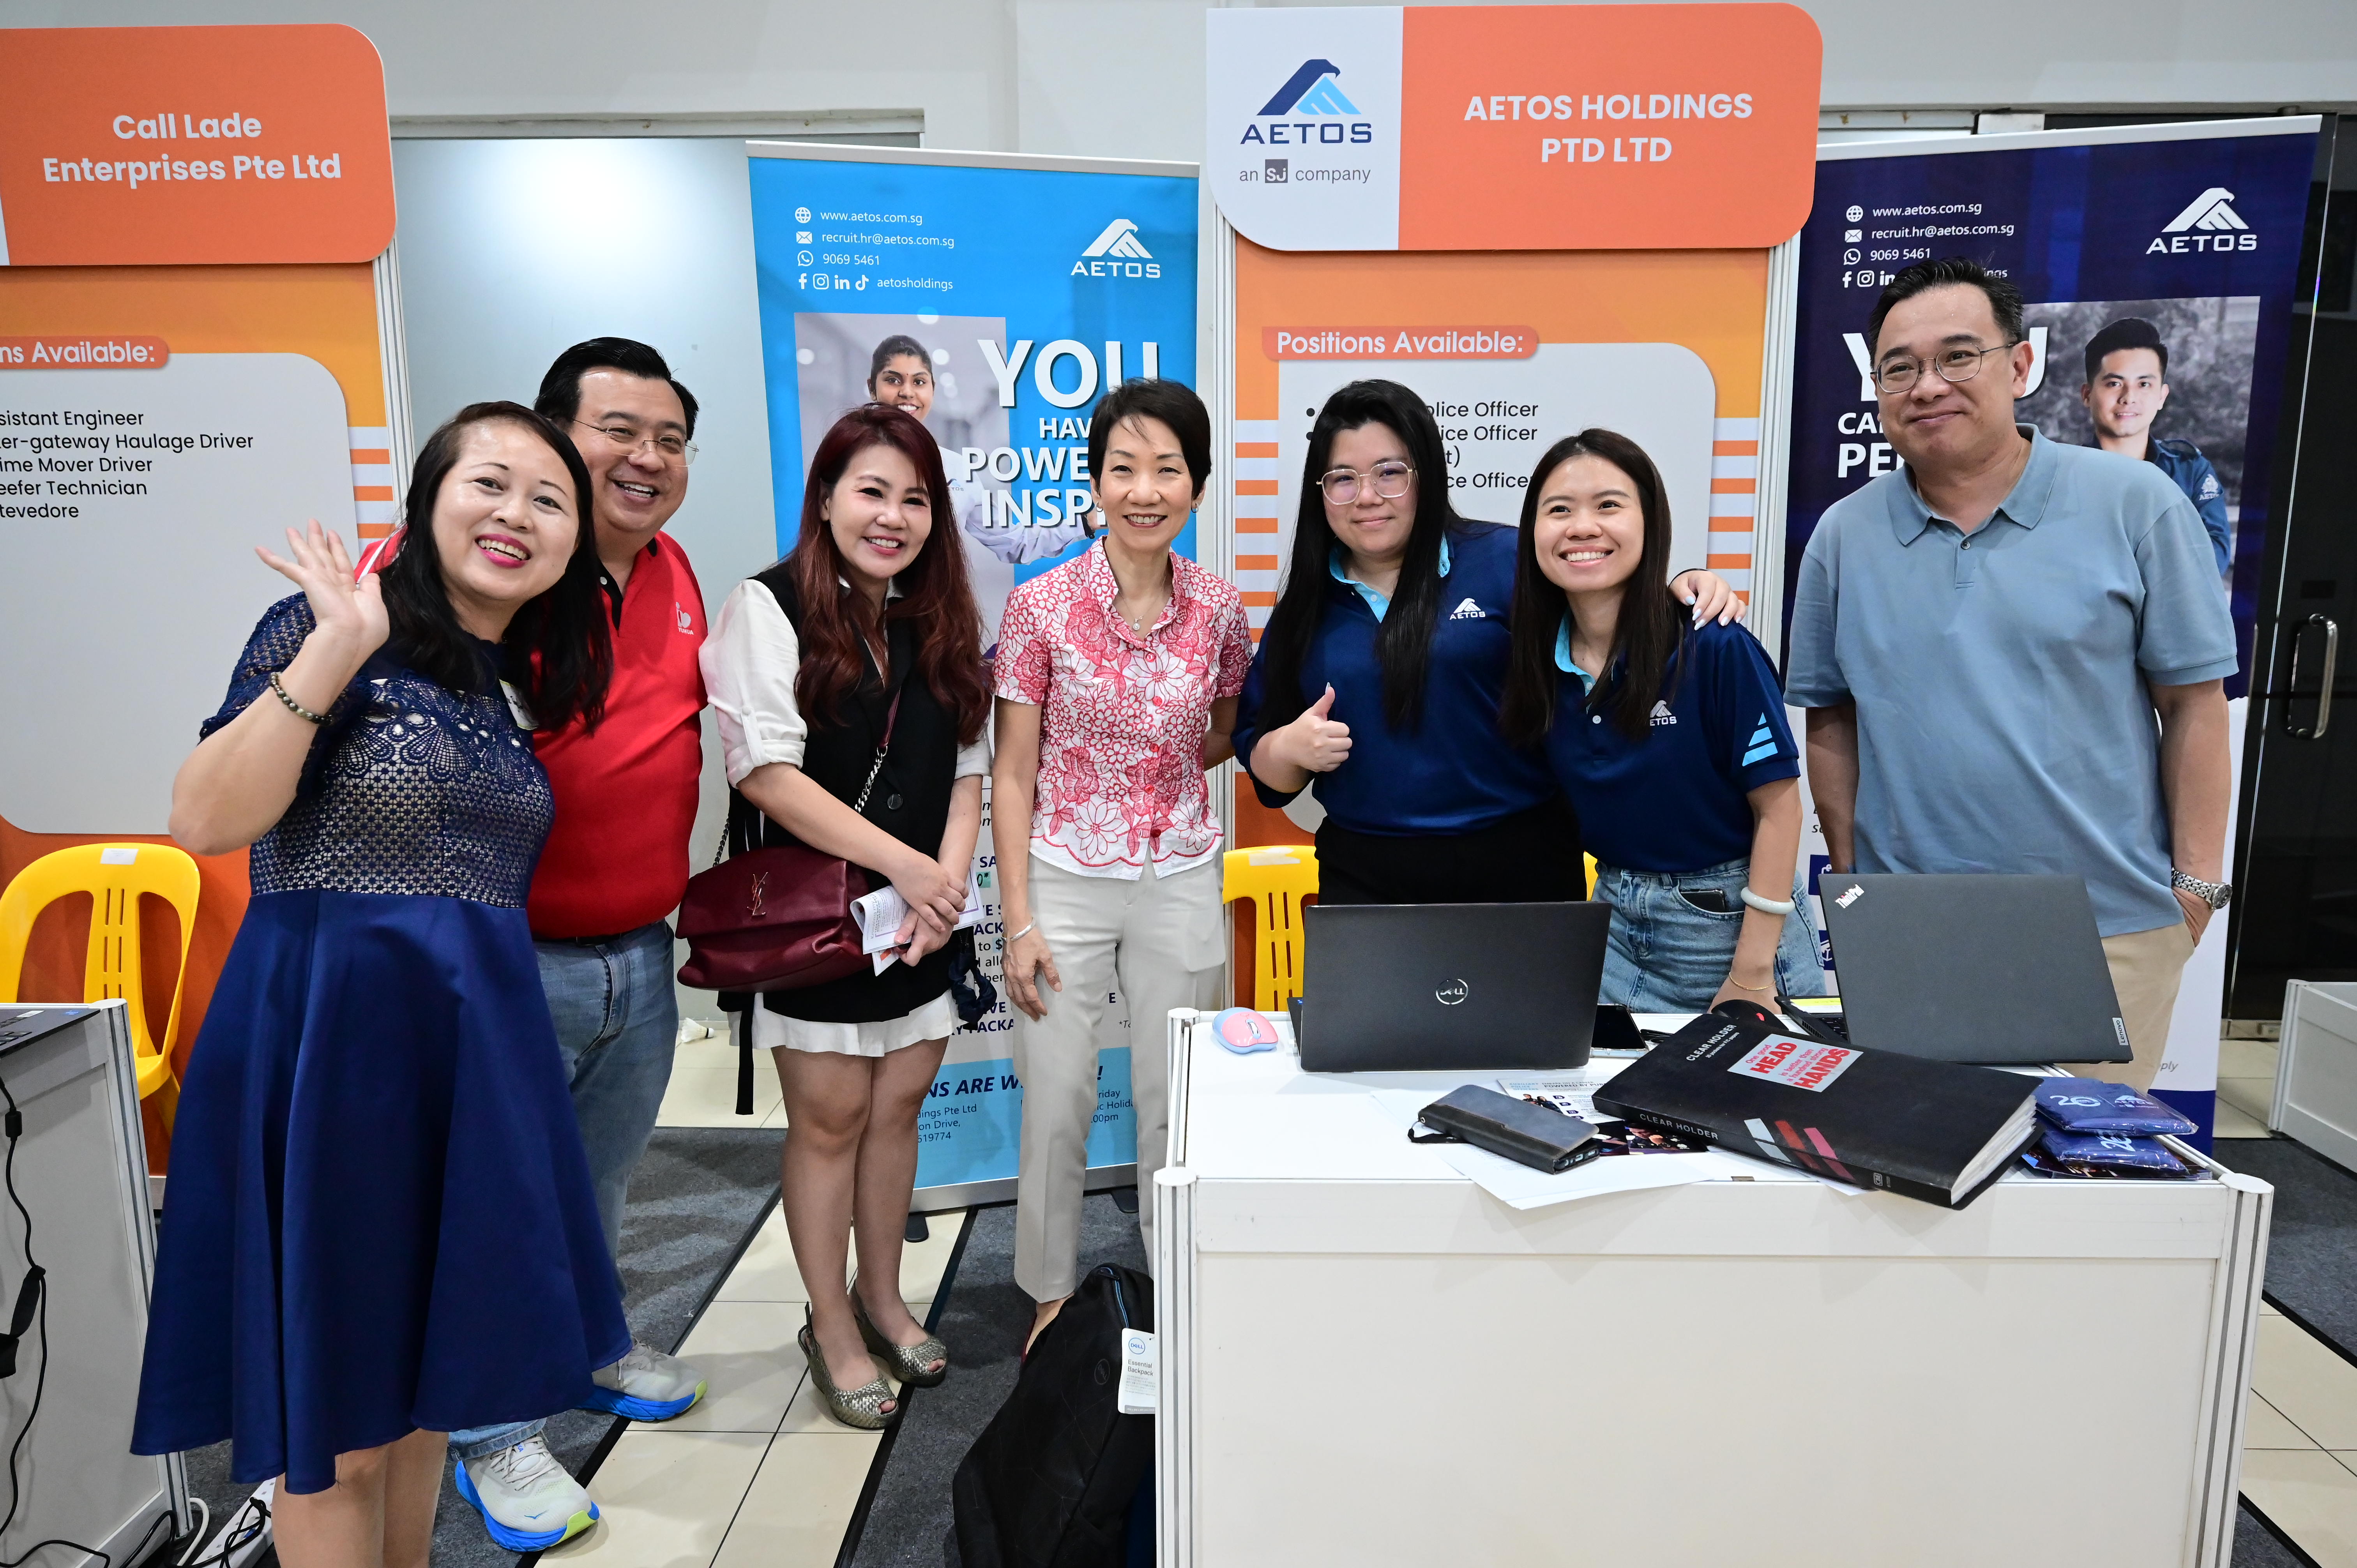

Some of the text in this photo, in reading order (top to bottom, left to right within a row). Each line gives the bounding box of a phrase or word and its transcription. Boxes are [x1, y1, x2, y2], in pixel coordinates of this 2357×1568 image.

[1463, 93, 1753, 121] AETOS HOLDINGS
[113, 113, 261, 139] Call Lade
[1240, 123, 1371, 144] AETOS
[1542, 136, 1672, 163] PTD LTD
[43, 153, 341, 189] Enterprises Pte Ltd
[1240, 170, 1258, 181] an
[1296, 169, 1371, 184] company
[820, 212, 922, 226] www.aetos.com.sg
[1873, 203, 1982, 217] www.aetos.com.sg
[1871, 222, 2014, 240] recruit.hr@aetos.com.sg
[822, 233, 954, 249] recruit.hr@aetos.com.sg
[2146, 234, 2256, 255] AETOS
[823, 254, 880, 265] 9069 5461
[1870, 248, 1930, 261] 9069 5461
[1071, 261, 1161, 279] AETOS
[877, 277, 953, 291] aetosholdings
[1277, 330, 1523, 354] Positions Available:
[32, 341, 155, 363] Available:
[1475, 401, 1538, 417] Officer
[64, 411, 143, 430] Engineer
[1039, 418, 1092, 438] HAV
[1838, 412, 1882, 434] CA
[1440, 425, 1537, 440] ice Officer
[116, 433, 194, 454] Haulage
[200, 434, 253, 449] Driver
[39, 458, 93, 472] Mover
[99, 457, 152, 472] Driver
[962, 447, 1090, 481] POWE
[1838, 443, 1904, 478] PE
[46, 480, 147, 495] Technician
[1473, 472, 1531, 487] Office
[1449, 611, 1486, 620] AETOS
[678, 627, 694, 635] YUHUA
[1649, 716, 1677, 727] ETOS
[1835, 884, 1864, 909] ThinkPad
[975, 922, 1004, 935] ACK
[978, 942, 991, 951] to
[977, 1019, 1014, 1033] ACKA
[2116, 1020, 2126, 1044] Lenovo
[1686, 1024, 1737, 1061] CLEAR HOLDER
[1758, 1044, 1772, 1055] good
[1750, 1042, 1797, 1074] HEAD
[1784, 1059, 1802, 1072] better
[1799, 1049, 1814, 1059] than
[1789, 1061, 1813, 1078] hundred
[1810, 1048, 1829, 1061] strong
[1793, 1048, 1850, 1088] HANDS
[955, 1077, 995, 1095] ARE
[1099, 1090, 1120, 1098] riday
[945, 1107, 959, 1115] Pte
[963, 1104, 977, 1113] Ltd
[934, 1119, 960, 1129] Drive,
[1640, 1114, 1718, 1140] CLEAR HOLDER
[1127, 1366, 1154, 1377] Backpack
[1128, 1359, 1152, 1368] Essential
